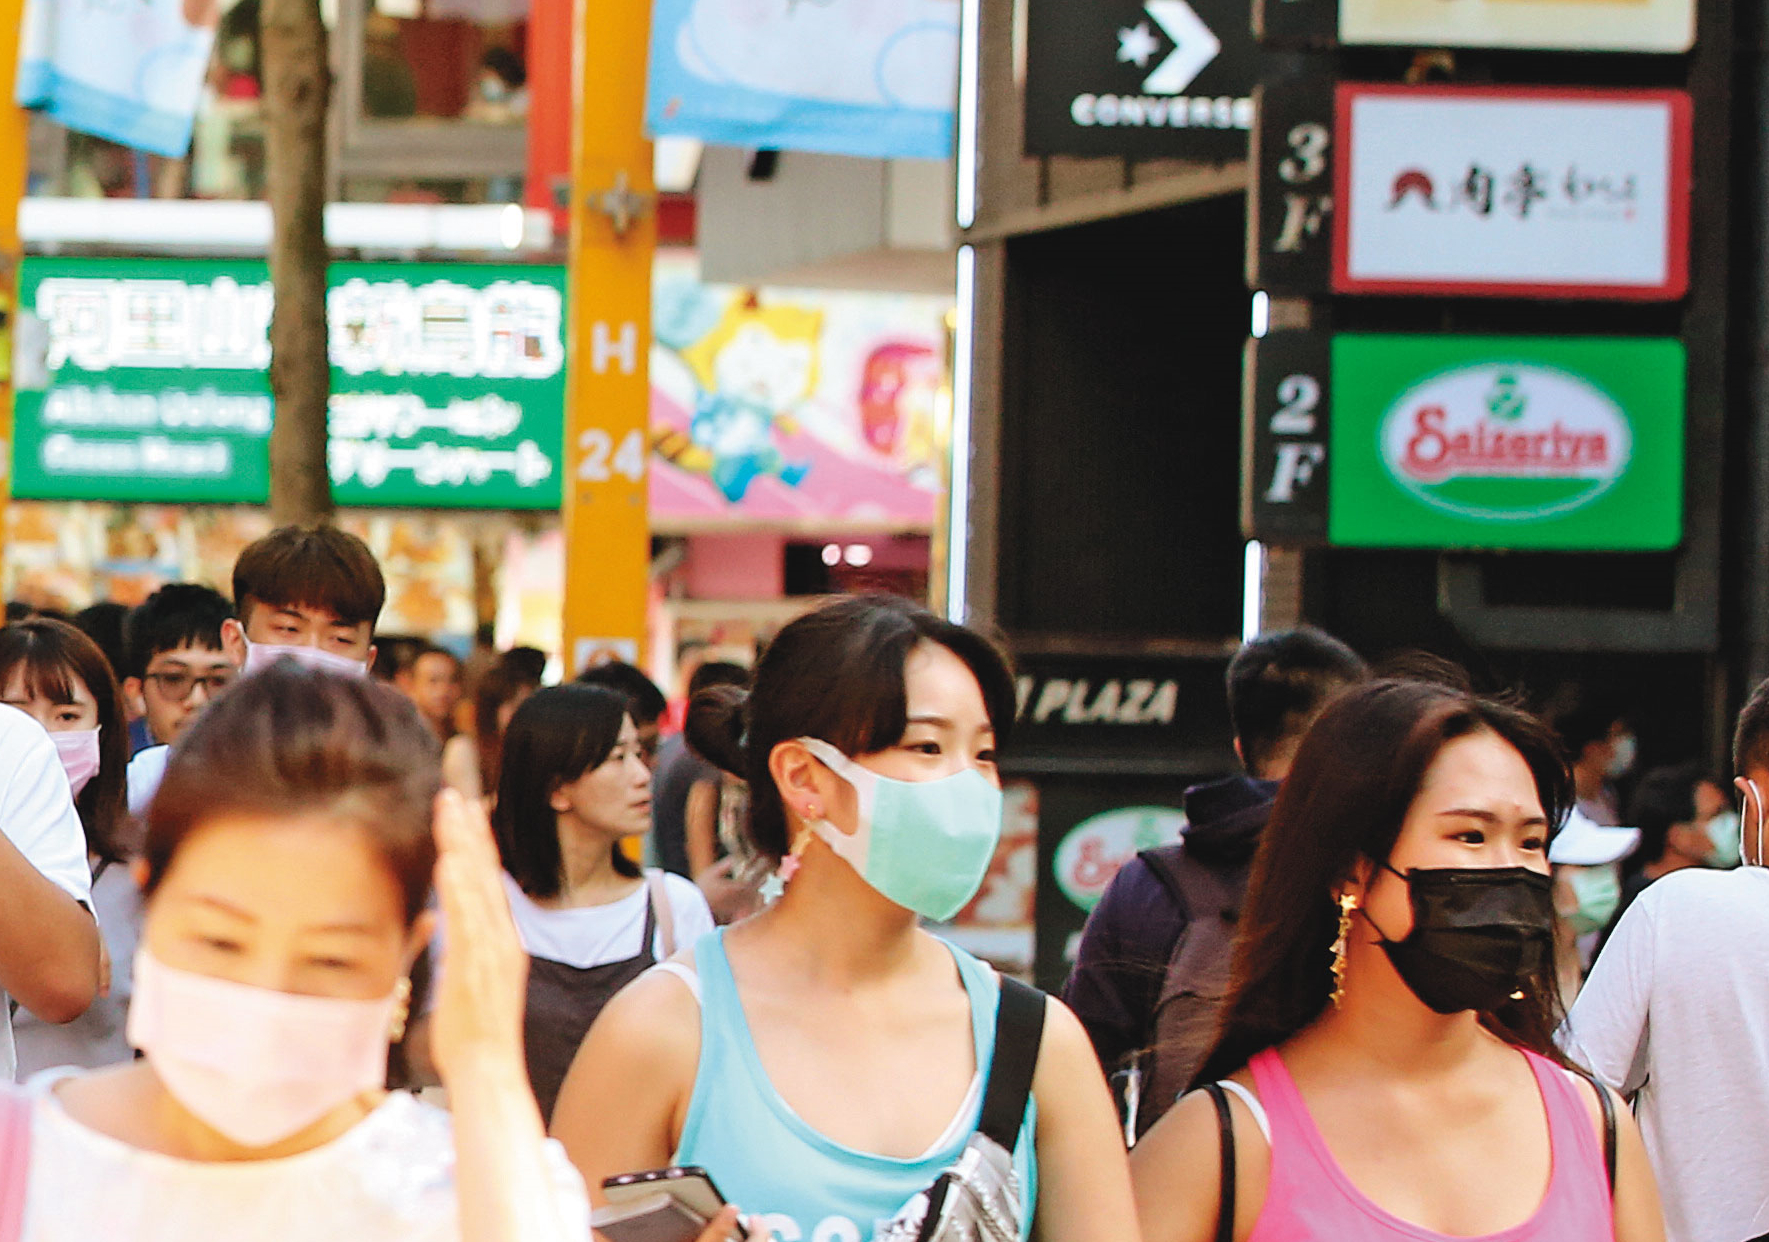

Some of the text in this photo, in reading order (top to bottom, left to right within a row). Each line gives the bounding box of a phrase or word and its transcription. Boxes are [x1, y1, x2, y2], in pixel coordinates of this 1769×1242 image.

[1070, 93, 1254, 129] CONVERSE
[591, 318, 638, 376] H
[577, 427, 645, 483] 24
[1402, 403, 1609, 484] Saizeriya
[1035, 678, 1179, 724] PLAZA
